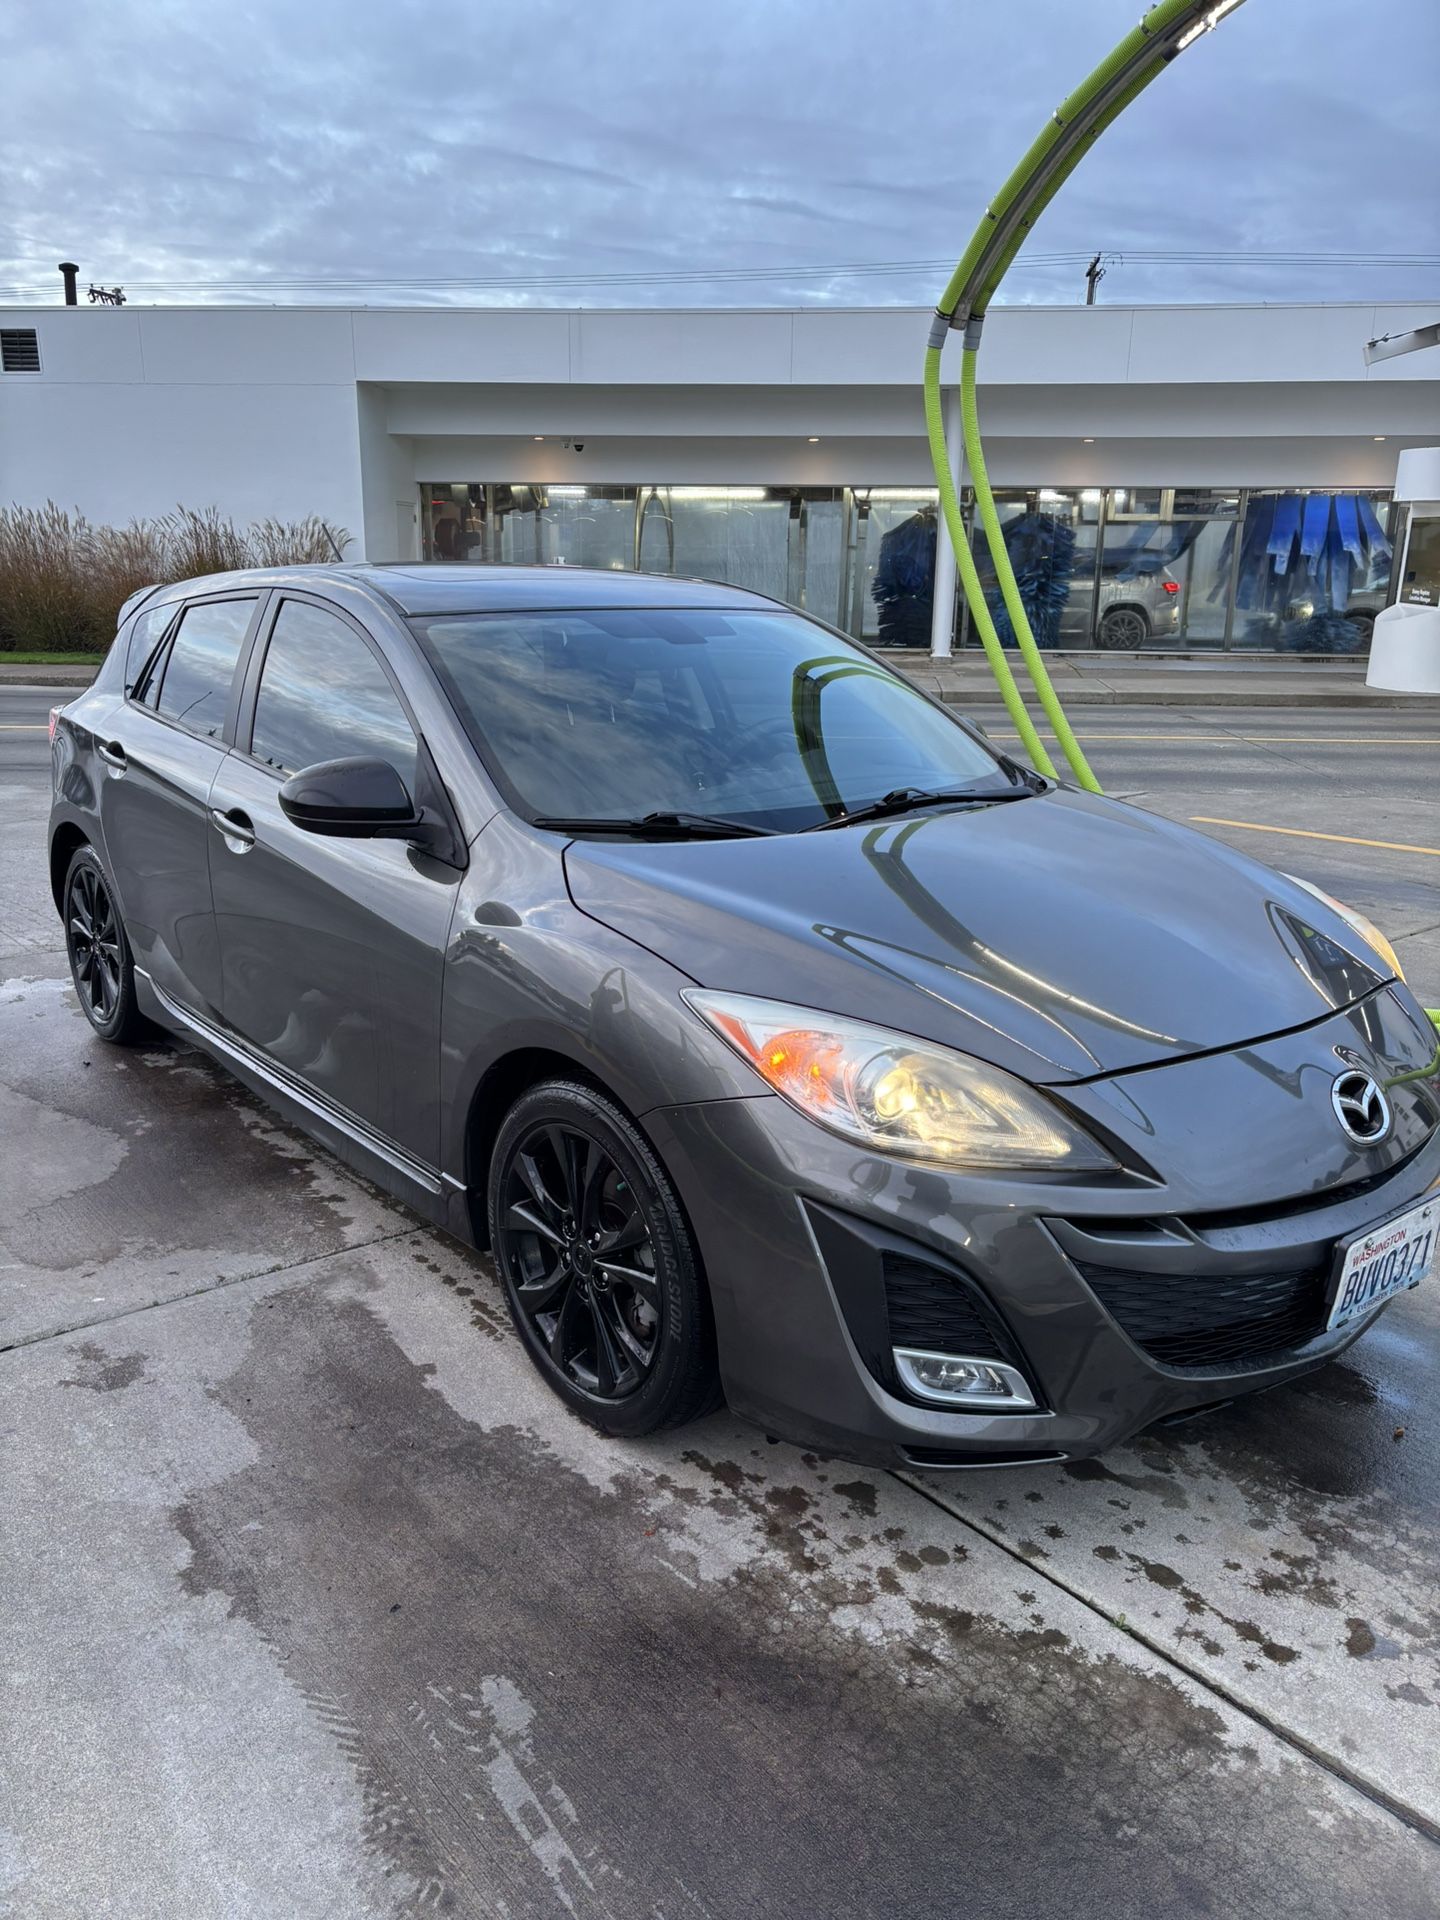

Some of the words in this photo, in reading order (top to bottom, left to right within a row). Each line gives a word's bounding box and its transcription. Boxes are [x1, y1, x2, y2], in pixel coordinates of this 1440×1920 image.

[650, 1201, 682, 1343] BRIDGESTONE
[1340, 1229, 1433, 1314] BUV0371
[1352, 1228, 1407, 1268] WASHINGTON
